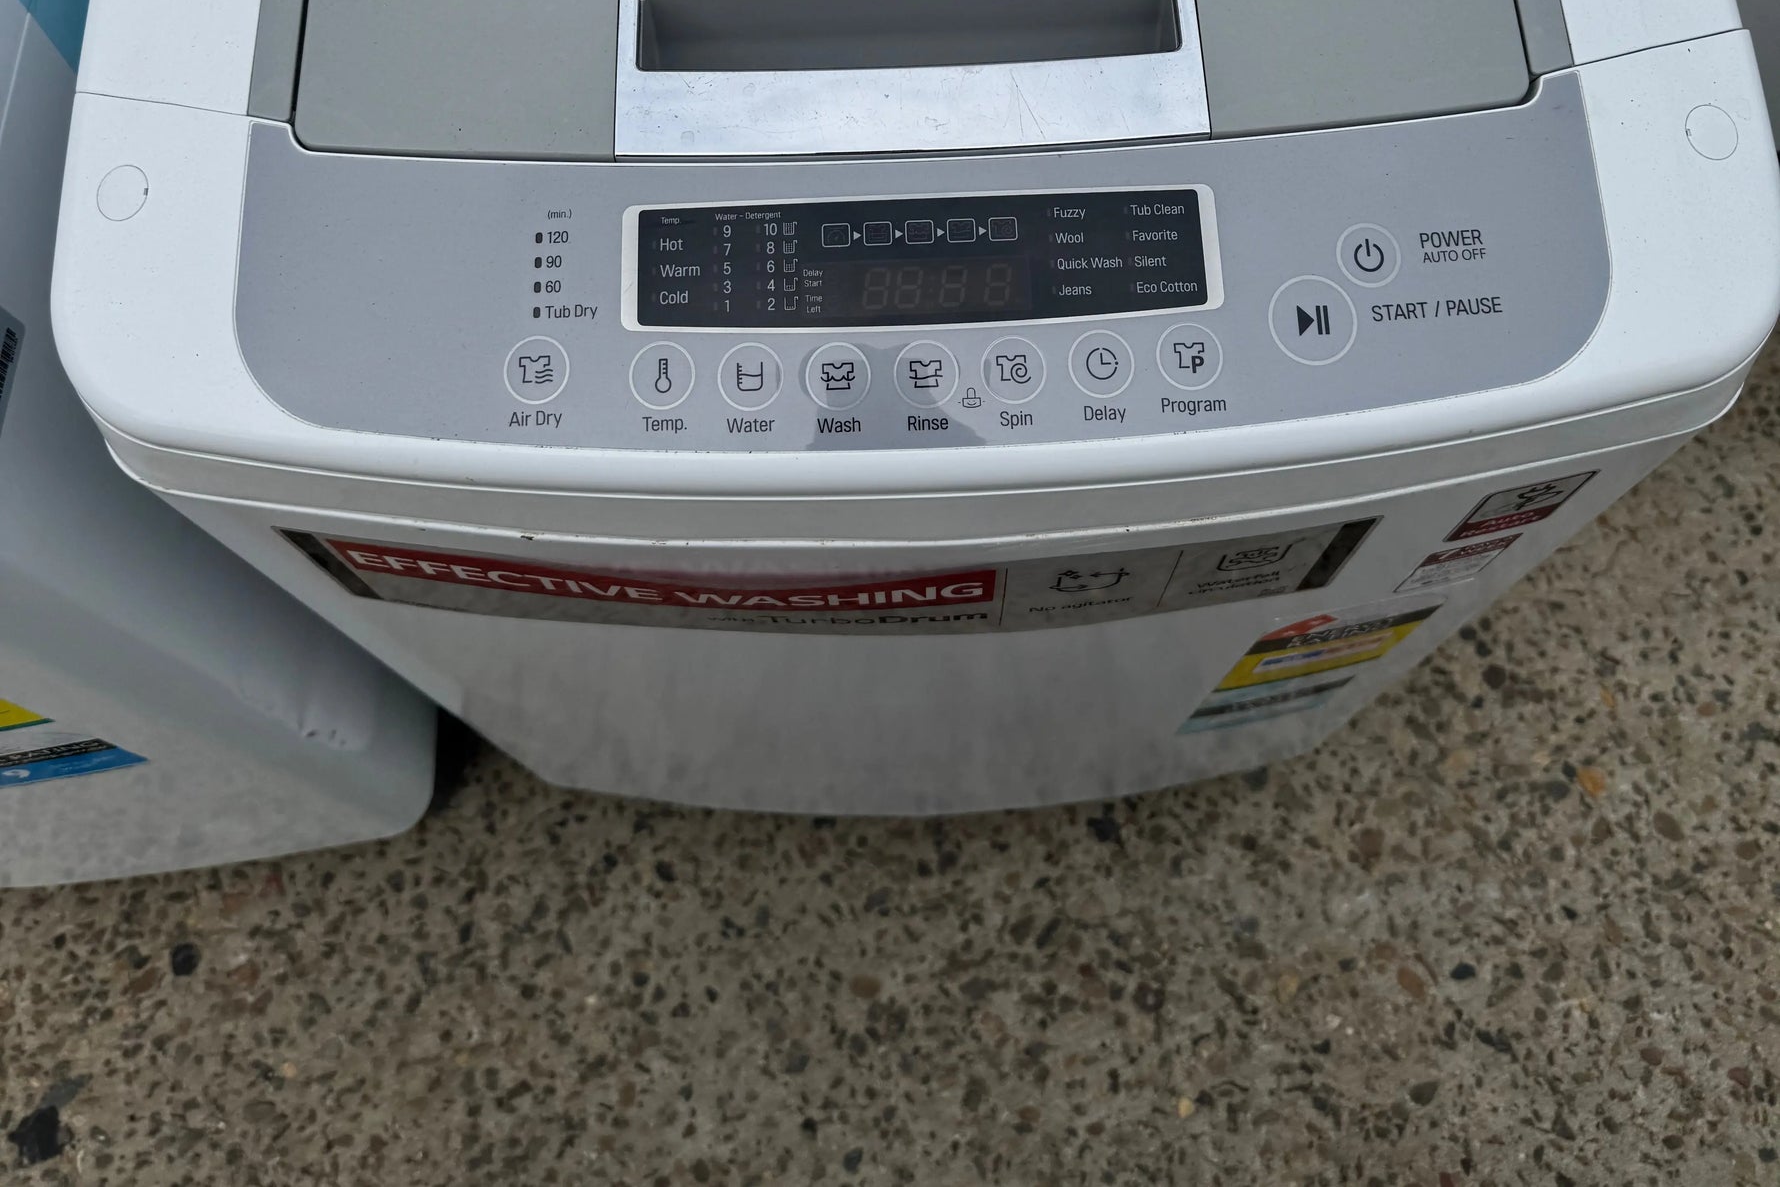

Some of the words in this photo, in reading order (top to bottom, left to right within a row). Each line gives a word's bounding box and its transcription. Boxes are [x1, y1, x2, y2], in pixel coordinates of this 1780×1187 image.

[547, 208, 572, 220] (min.)
[745, 212, 781, 221] Detergent
[1054, 206, 1086, 220] Fuzzy
[1130, 204, 1151, 216] Tub
[1154, 204, 1185, 215] Clean
[723, 224, 732, 238] 9
[764, 222, 778, 236] 10
[1132, 230, 1178, 242] Favorite
[546, 230, 569, 244] 120
[1055, 232, 1084, 244] Wool
[1419, 229, 1483, 249] POWER
[660, 238, 684, 252] Hot
[723, 243, 732, 256] 7
[766, 241, 775, 254] 8
[546, 256, 562, 269] 90
[1134, 256, 1167, 268] Silent
[1422, 250, 1458, 264] AUTO
[1462, 248, 1487, 261] OFF
[660, 264, 700, 278] Warm
[723, 262, 732, 275] 5
[766, 260, 775, 273] 6
[1057, 258, 1088, 271] Quick
[1090, 257, 1123, 269] Wash
[802, 268, 824, 279] Delay
[546, 280, 562, 294] 60
[723, 280, 732, 294] 3
[767, 278, 776, 292] 4
[804, 278, 823, 288] Start
[1058, 284, 1092, 296] Jeans
[1136, 281, 1158, 293] Eco
[1160, 280, 1198, 293] Cotton
[660, 290, 689, 305] Cold
[768, 298, 776, 311] 2
[805, 294, 823, 303] Time
[545, 305, 570, 318] Tub
[574, 304, 598, 320] Dry
[724, 300, 730, 313] 1
[806, 304, 822, 314] Left
[1371, 302, 1428, 322] START
[1434, 300, 1440, 318] /
[1446, 296, 1504, 316] PAUSE
[1160, 396, 1227, 416] Program
[509, 412, 532, 428] Air
[536, 410, 562, 428] Dry
[1000, 410, 1034, 430] Spin
[1084, 405, 1126, 424] Delay
[643, 416, 688, 433] Temp.
[726, 416, 775, 433] Water
[818, 417, 861, 433] Wash
[908, 416, 949, 431] Rinse
[346, 549, 664, 601] EFFECTIVE
[674, 582, 984, 607] WASHING
[1062, 596, 1135, 612] agitator
[759, 613, 988, 626] TurboDrum
